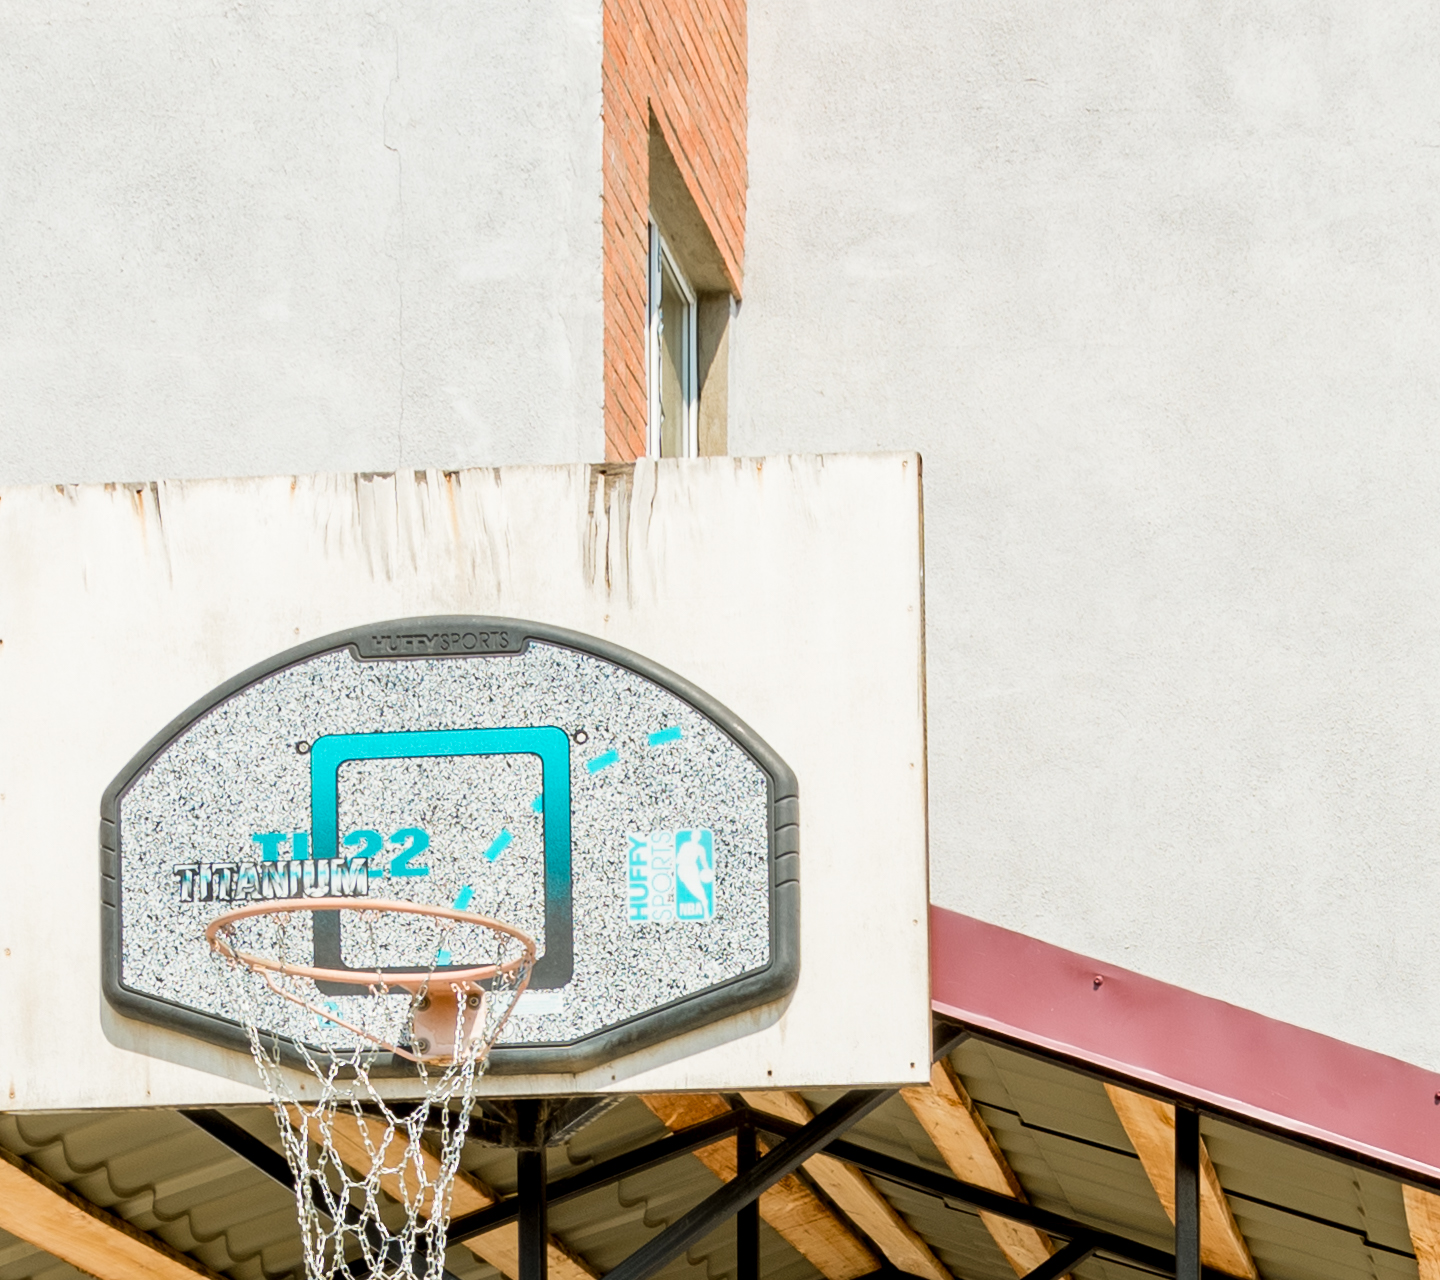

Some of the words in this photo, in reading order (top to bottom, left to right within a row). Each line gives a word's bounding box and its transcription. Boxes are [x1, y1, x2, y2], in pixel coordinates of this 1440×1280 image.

[371, 633, 439, 655] HUFFY
[439, 631, 509, 651] SPORTS
[343, 827, 430, 878] 22
[651, 832, 672, 920] SPORTS
[173, 857, 369, 902] TITANIUM
[628, 835, 649, 920] HUFFY
[679, 902, 703, 916] NBA
